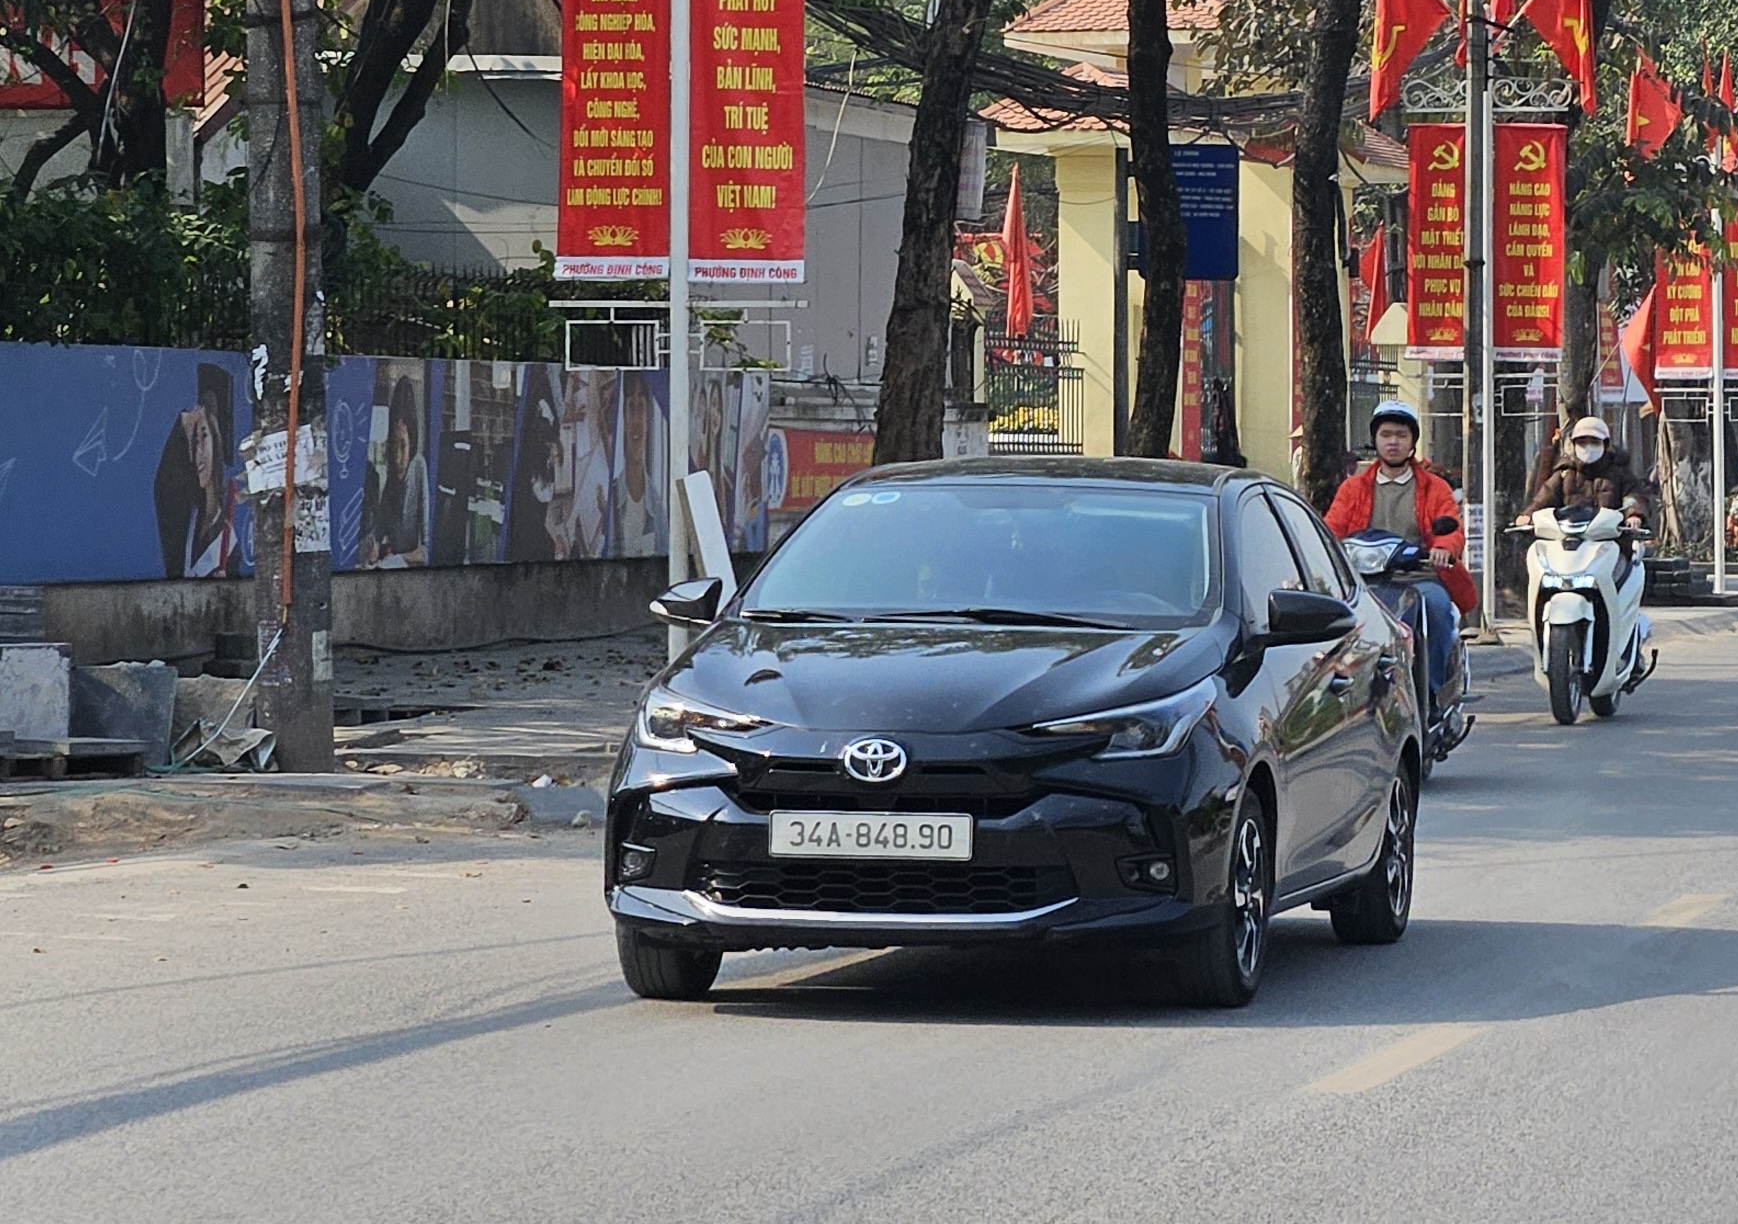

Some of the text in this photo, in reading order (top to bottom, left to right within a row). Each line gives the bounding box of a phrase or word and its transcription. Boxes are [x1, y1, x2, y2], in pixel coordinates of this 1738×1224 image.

[712, 21, 781, 56] SỨC MẠNH,
[607, 42, 622, 64] ĐẠI
[580, 66, 598, 89] LẤY
[600, 71, 625, 89] KHOA
[716, 58, 776, 94] BẢN LĨNH,
[586, 97, 612, 118] CÔNG
[723, 101, 769, 136] TRÍ TUỆ
[610, 126, 636, 148] SÁNG
[637, 130, 653, 151] TẠO
[573, 152, 654, 177] VÀ CHUYỂN ĐỔI SỐ
[701, 137, 793, 170] CỦA CON NGƯỜI
[586, 184, 611, 209] ĐỘNG
[613, 187, 630, 209] LỰC
[716, 179, 776, 214] VIỆT NAM!
[1534, 182, 1551, 196] CAO
[1534, 202, 1551, 220] LỰC
[635, 262, 663, 275] CÔNG
[694, 264, 798, 281] PHƯỜNG ĐỊNH CÔNG
[789, 820, 953, 850] 34A-848.90
